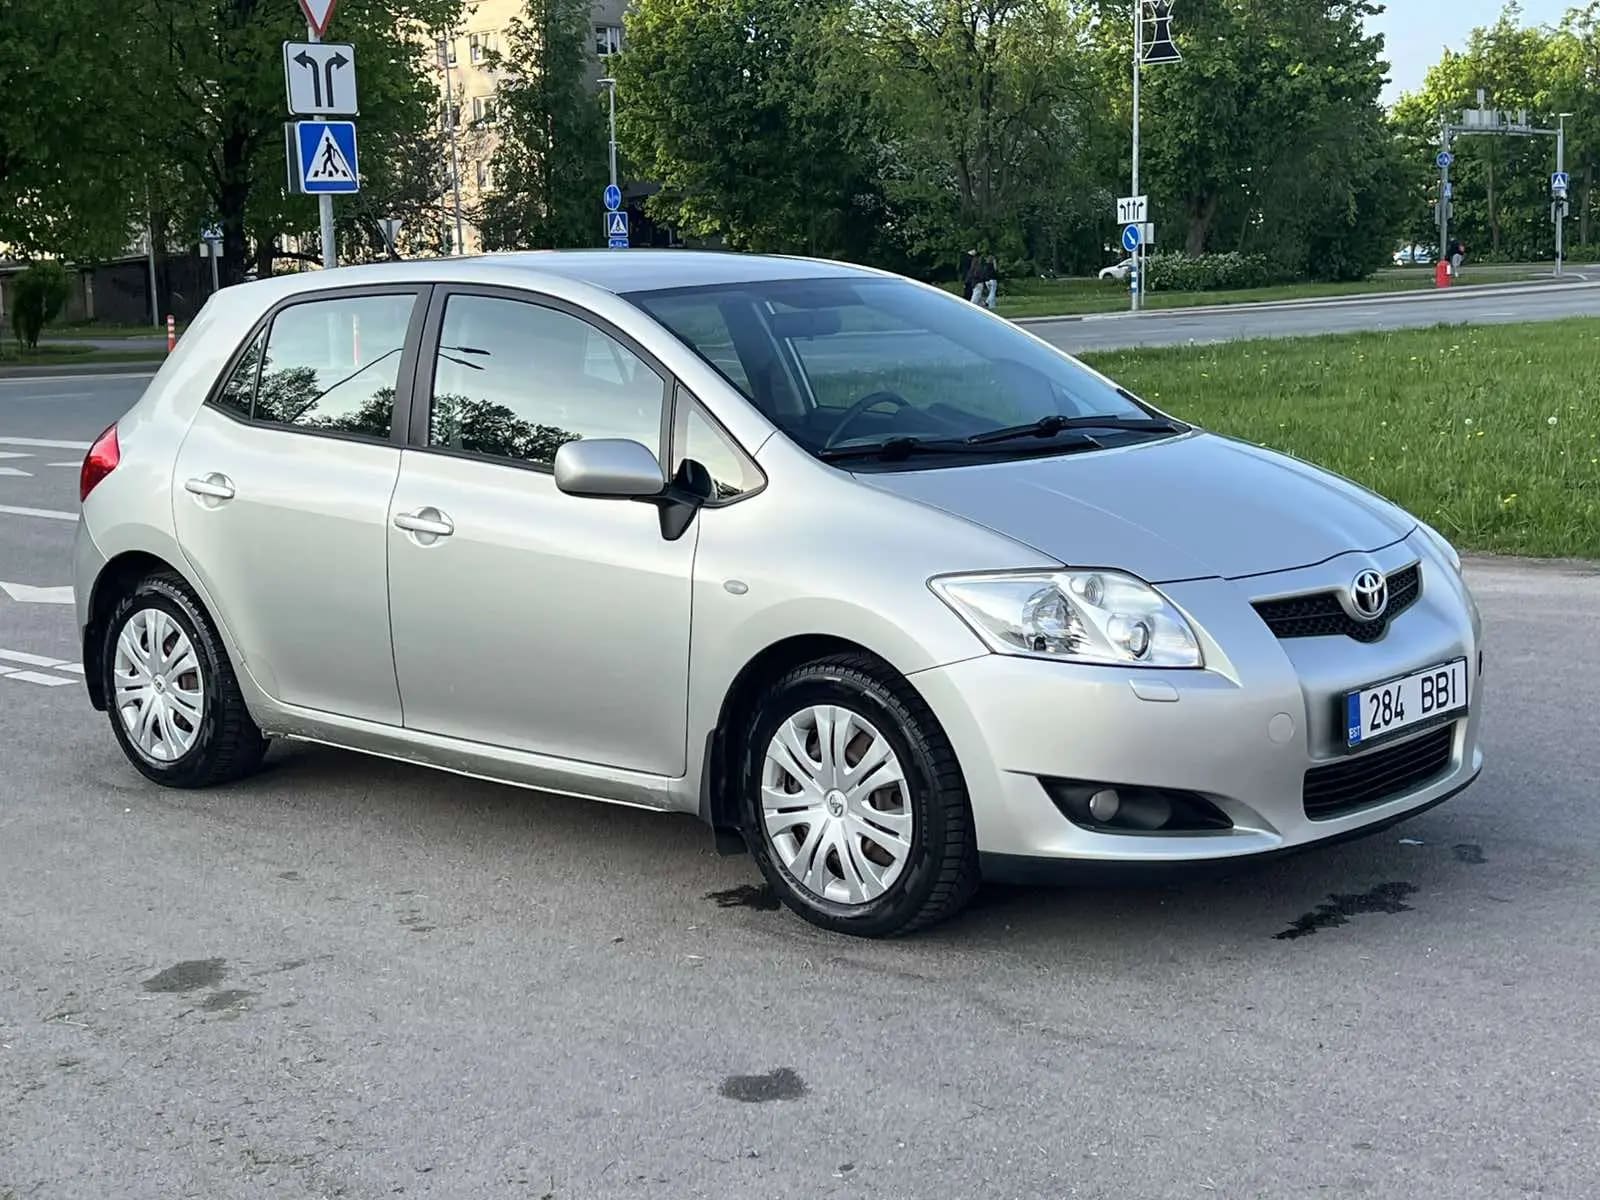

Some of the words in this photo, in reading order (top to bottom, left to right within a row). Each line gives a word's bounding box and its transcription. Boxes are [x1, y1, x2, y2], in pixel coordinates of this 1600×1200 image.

[1369, 685, 1405, 731] 284
[1421, 668, 1456, 714] BBI
[1348, 725, 1361, 739] EST
